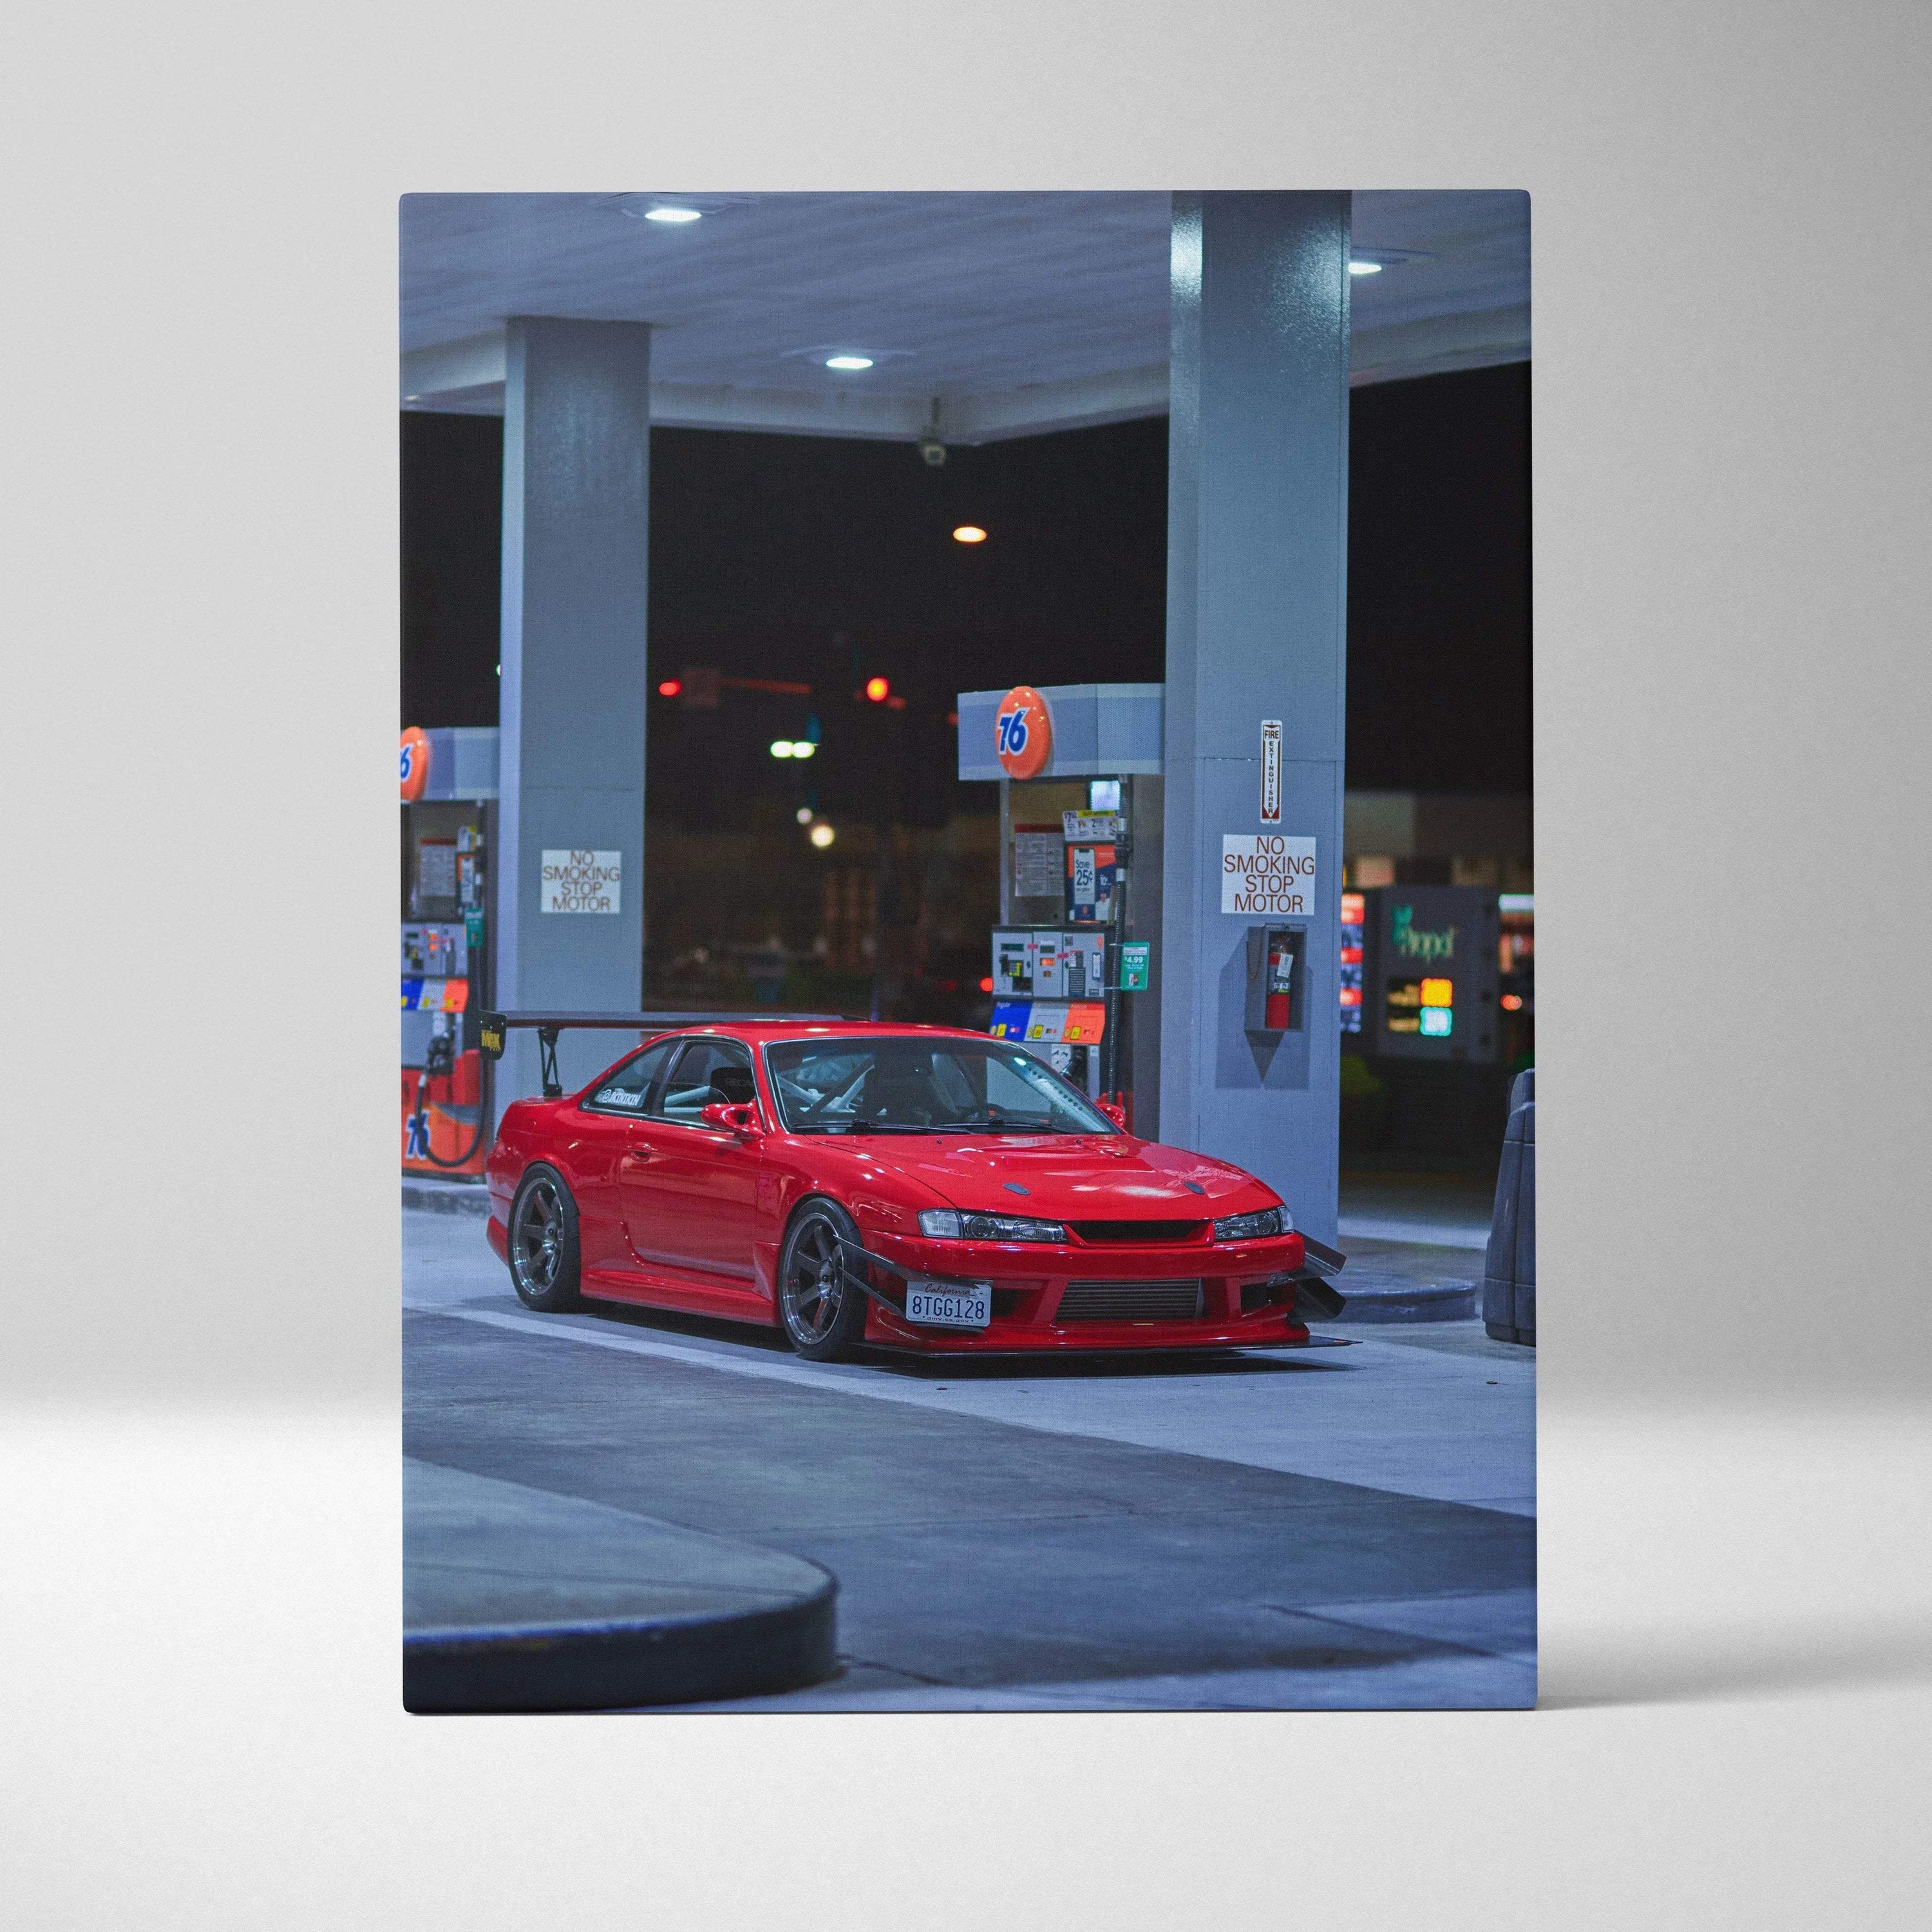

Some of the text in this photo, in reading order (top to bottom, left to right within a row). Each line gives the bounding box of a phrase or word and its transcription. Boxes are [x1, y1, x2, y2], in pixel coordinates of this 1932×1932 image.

[998, 707, 1029, 755] 76
[1264, 730, 1279, 739] FIRE
[401, 743, 414, 782] 6
[1256, 836, 1285, 855] NO
[571, 849, 594, 865] NO
[1075, 859, 1090, 869] Save
[1224, 855, 1315, 875] SMOKING
[543, 866, 620, 882] SMOKING
[1076, 869, 1093, 886] 25¢
[561, 882, 603, 896] STOP
[1245, 875, 1294, 894] STOP
[552, 896, 611, 911] MOTOR
[1235, 893, 1303, 913] MOTOR
[925, 1283, 973, 1297] California
[912, 1295, 985, 1320] 8TGG128
